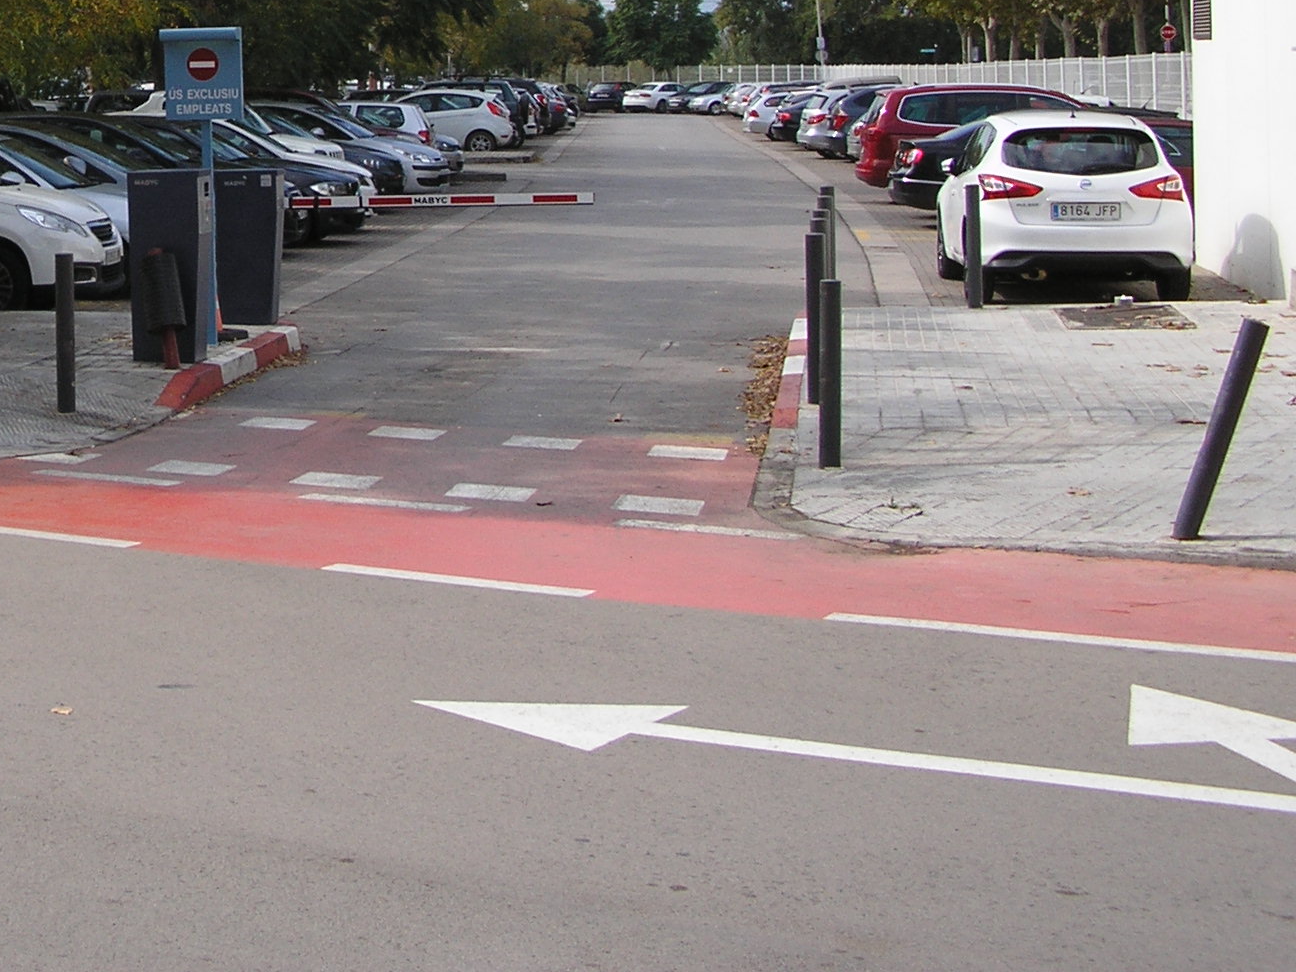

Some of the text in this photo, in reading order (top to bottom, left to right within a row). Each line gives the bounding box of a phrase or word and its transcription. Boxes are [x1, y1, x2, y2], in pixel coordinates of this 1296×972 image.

[187, 88, 239, 100] EXCLUSIU
[176, 103, 232, 115] EMPLEATS
[414, 196, 448, 204] MABYC
[1060, 205, 1117, 216] 8164 JFP
